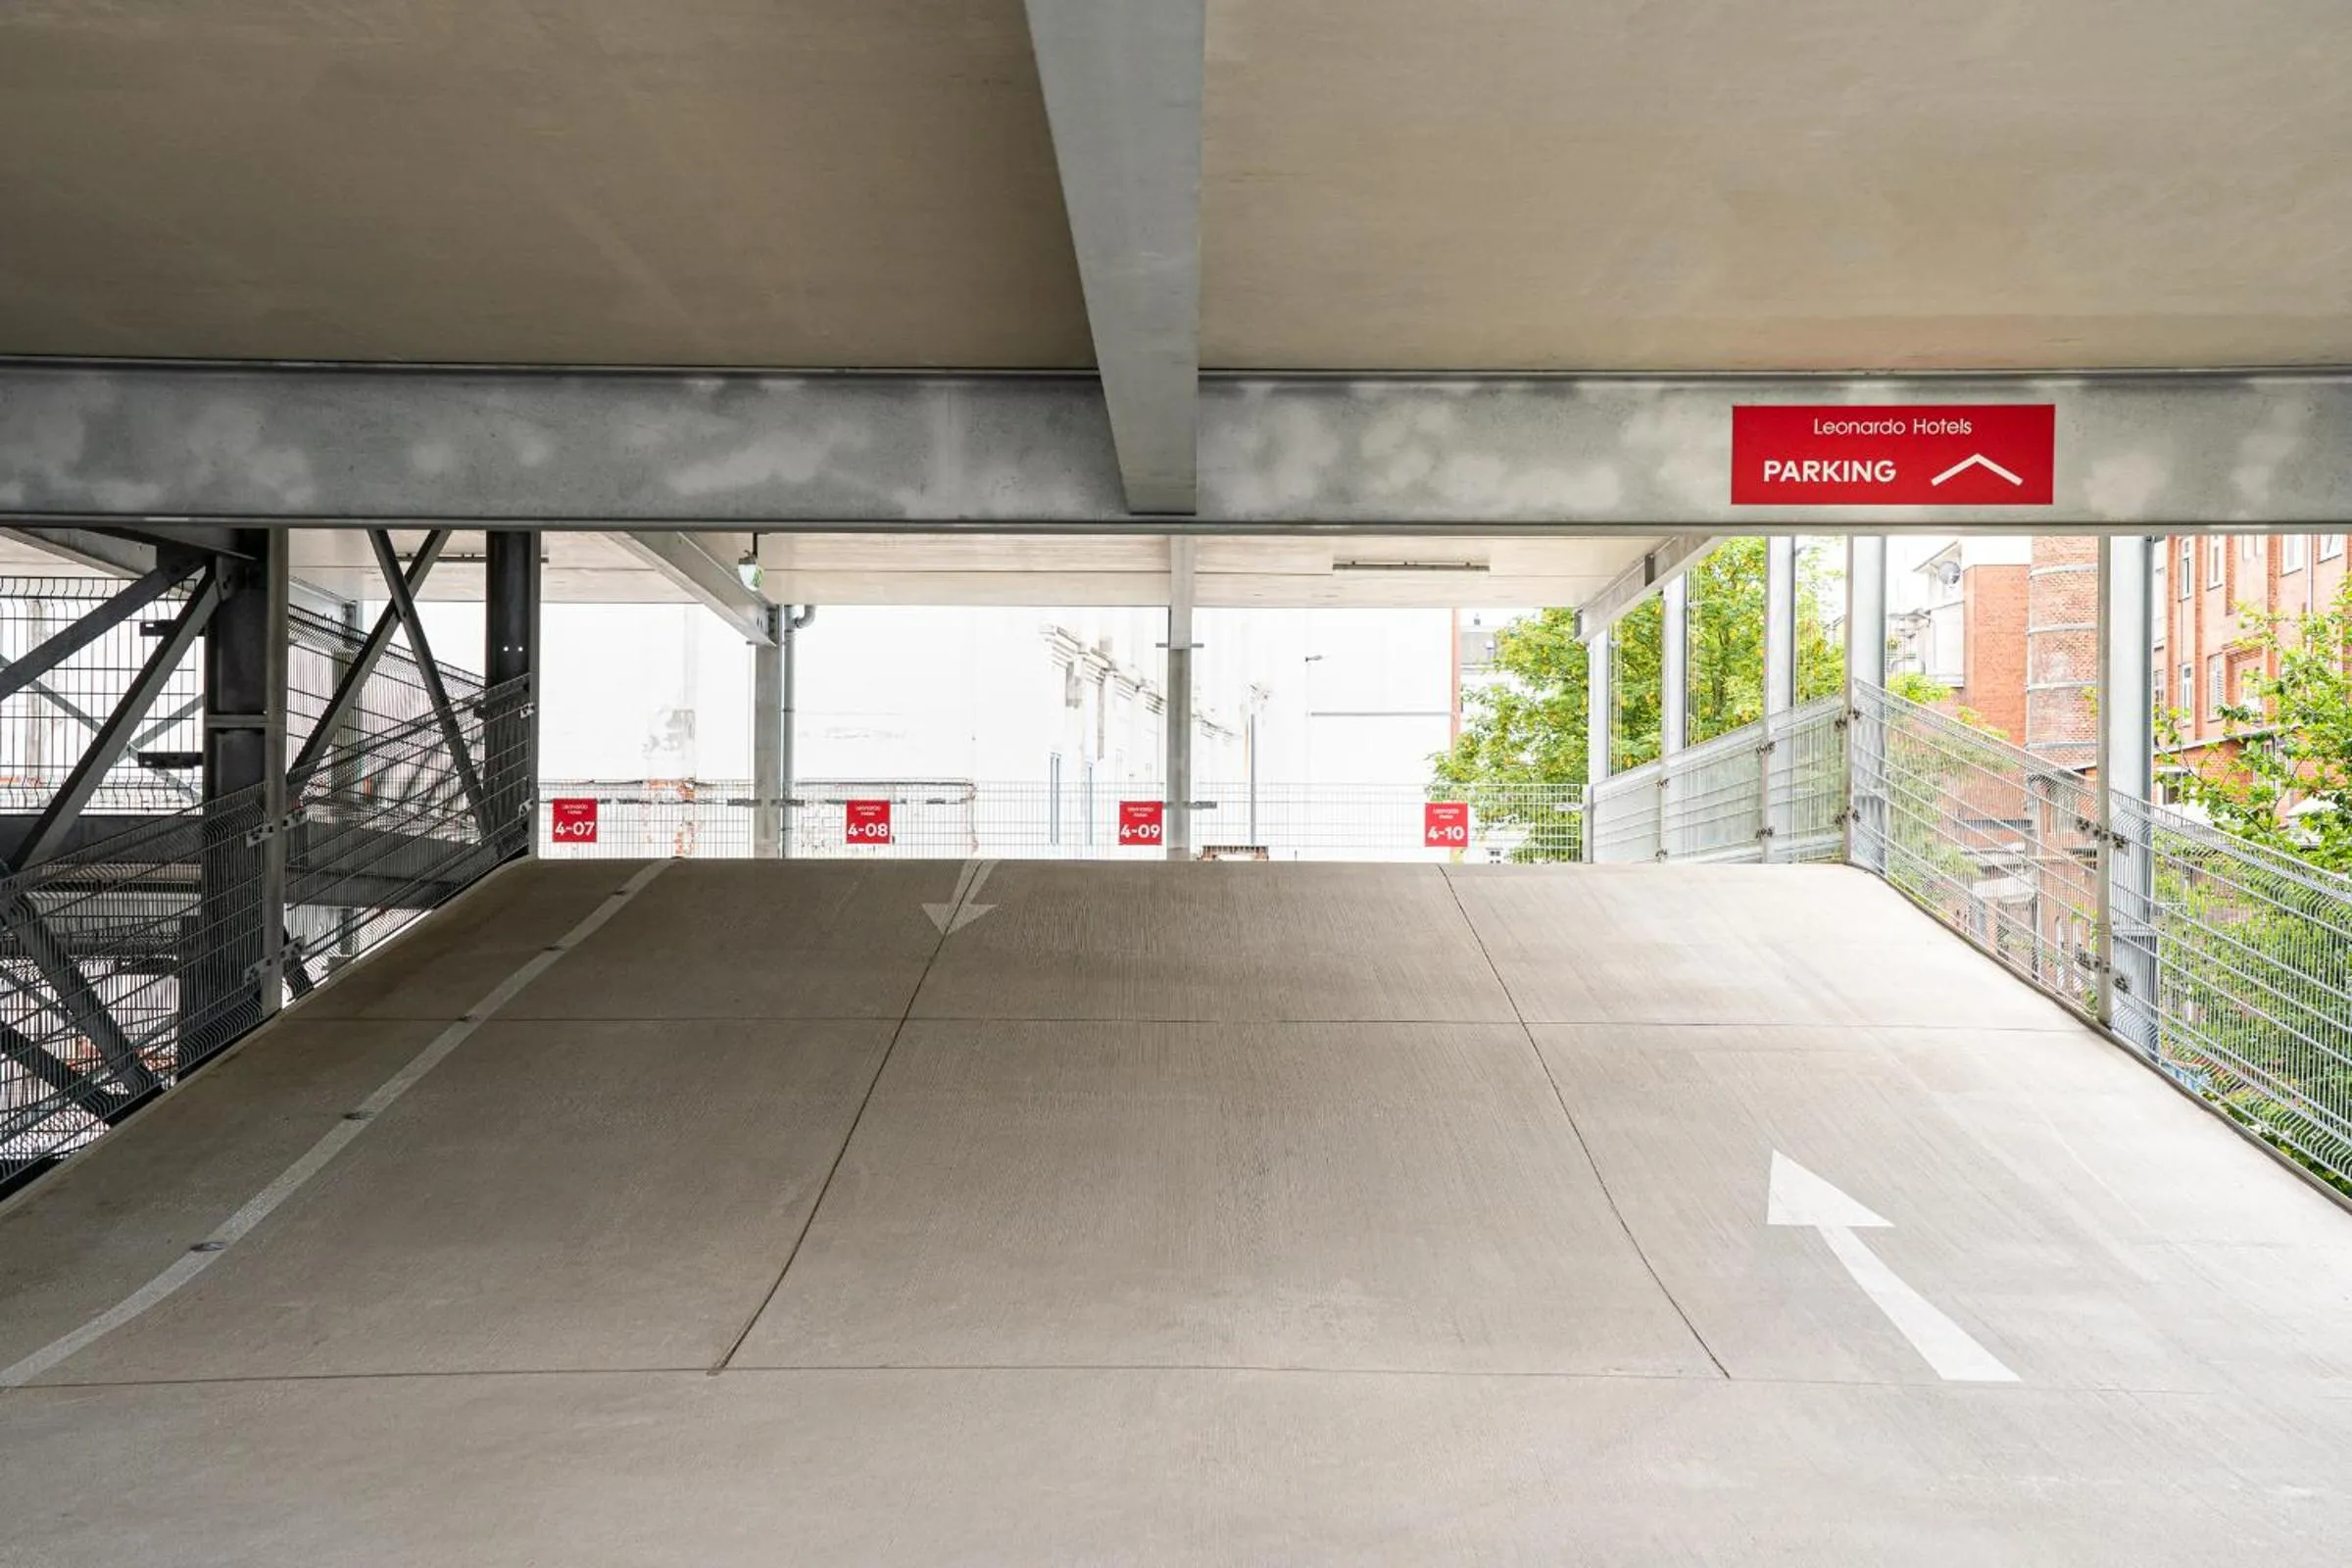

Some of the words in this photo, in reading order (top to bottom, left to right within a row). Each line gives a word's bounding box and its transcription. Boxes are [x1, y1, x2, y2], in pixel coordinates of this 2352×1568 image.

[1813, 417, 1906, 435] Leonardo
[1913, 417, 1973, 435] Hotels
[1763, 460, 1897, 483] PARKING
[555, 821, 595, 836] 4-07
[848, 822, 888, 837] 4-08
[1120, 823, 1161, 839] 4-09
[1428, 825, 1465, 841] 4-10
